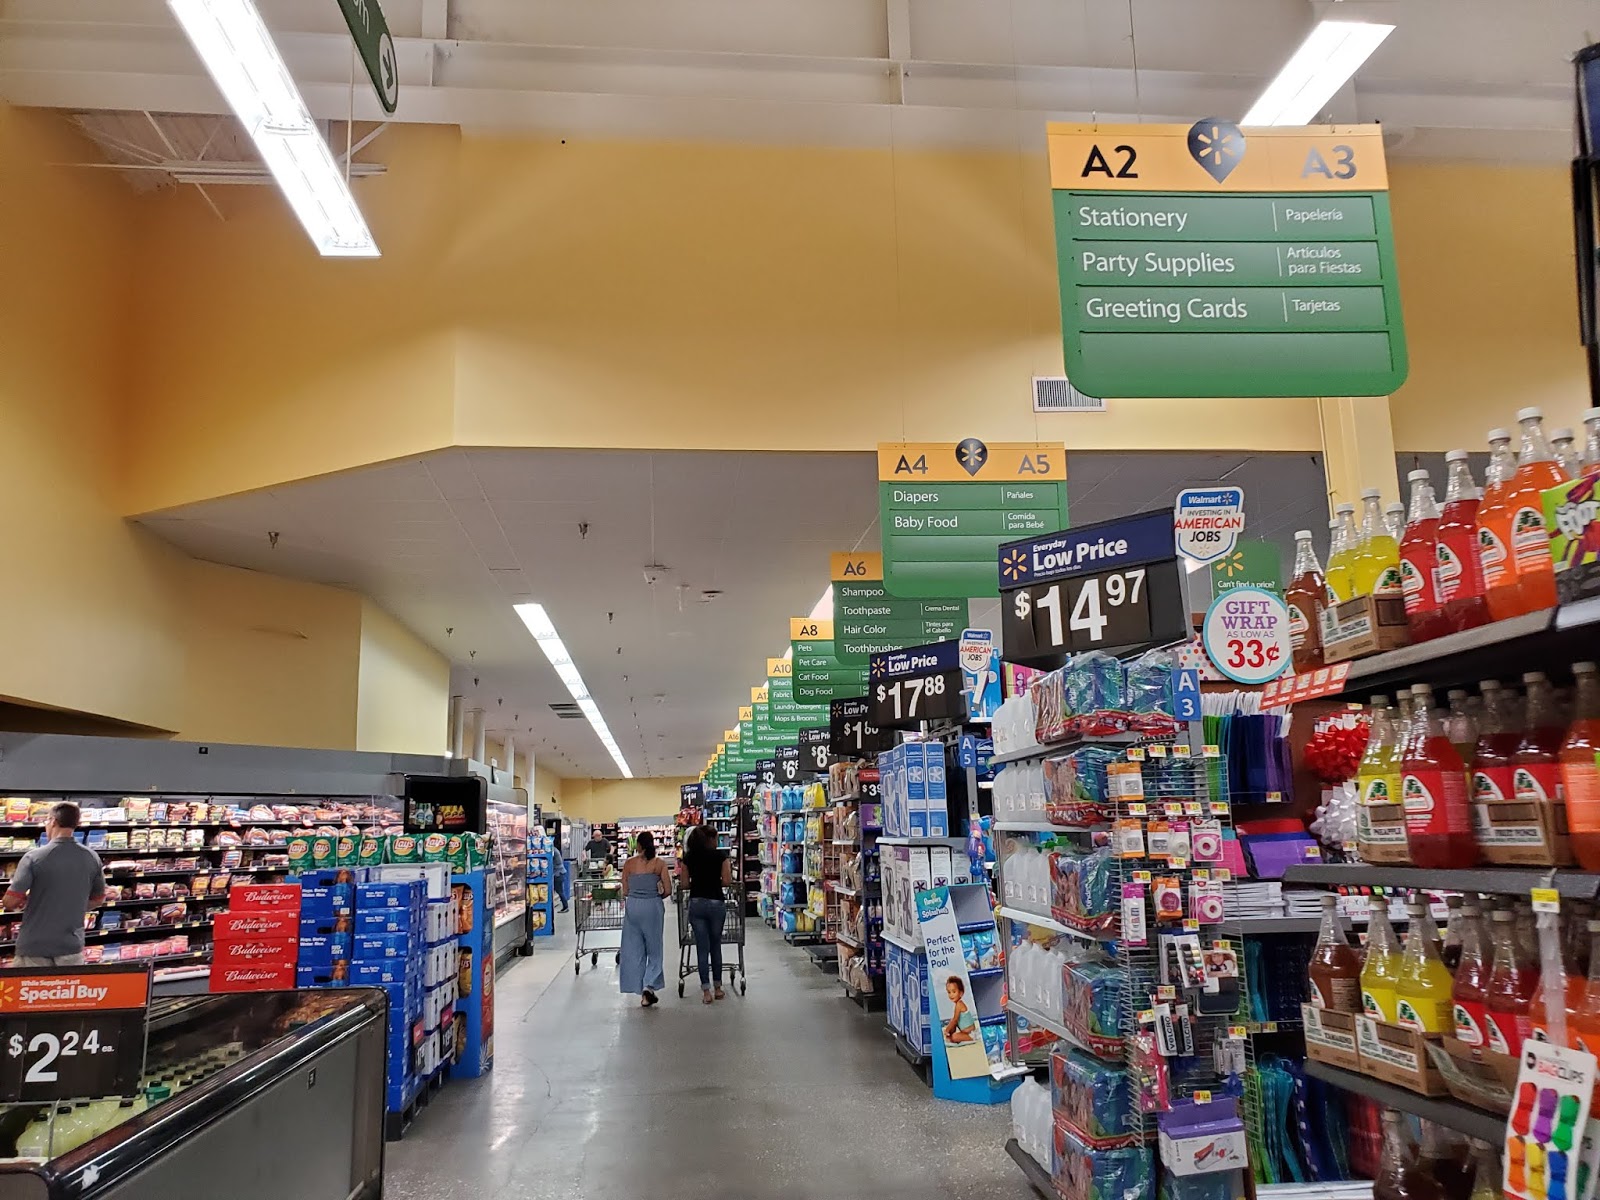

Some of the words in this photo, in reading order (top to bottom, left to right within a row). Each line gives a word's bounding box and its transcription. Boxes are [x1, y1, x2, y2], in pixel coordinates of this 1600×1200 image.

[1081, 145, 1138, 178] A2
[1302, 145, 1357, 179] A3
[1079, 206, 1188, 232] Stationery
[1286, 208, 1343, 223] Papelería
[1287, 246, 1341, 260] Artículos
[1082, 252, 1138, 276] Party
[1145, 252, 1235, 277] Supplies
[1288, 263, 1316, 277] para
[1319, 262, 1362, 275] Fiestas
[1086, 297, 1181, 323] Greeting
[1187, 297, 1248, 319] Cards
[1291, 299, 1341, 313] Tarjetas
[894, 454, 928, 475] A4
[1018, 454, 1050, 475] A5
[893, 491, 939, 503] Diapers
[1006, 491, 1034, 500] Pañales
[1188, 495, 1221, 504] Walmart
[1008, 512, 1036, 520] Comida
[895, 516, 924, 531] Baby
[927, 516, 958, 528] Food
[1008, 522, 1024, 530] para
[1026, 521, 1045, 529] Bebé
[1174, 517, 1241, 529] AMERICAN
[1189, 531, 1221, 543] JOBS
[1033, 540, 1067, 553] Everyday
[1033, 550, 1073, 571] Low
[1076, 538, 1128, 562] Price
[844, 561, 866, 576] A6
[842, 588, 884, 598] Shampoo
[842, 606, 891, 617] Toothpaste
[1225, 601, 1270, 615] GIFT
[1221, 616, 1277, 629] WRAP
[800, 625, 818, 636] A8
[843, 625, 861, 634] Hair
[863, 625, 887, 634] Color
[798, 644, 812, 652] Pets
[960, 646, 991, 654] AMERICAN
[1227, 640, 1280, 668] 33¢
[773, 664, 791, 673] A10
[799, 659, 811, 667] Pet
[888, 660, 910, 673] Low
[911, 654, 938, 669] Price
[798, 673, 808, 681] Cat
[809, 673, 829, 681] Food
[757, 692, 769, 700] A1
[799, 688, 814, 697] Dog
[815, 687, 833, 696] Food
[844, 705, 859, 714] Low
[244, 891, 294, 902] Budweiser
[229, 920, 282, 930] Budweiser
[926, 933, 955, 947] Perfect
[229, 945, 282, 955] Budweiser
[928, 948, 940, 958] for
[941, 946, 955, 956] the
[931, 957, 949, 968] Pool
[224, 970, 278, 981] Budweiser
[19, 985, 74, 1004] Special
[77, 985, 108, 1001] Buy
[102, 1044, 115, 1053] ea.
